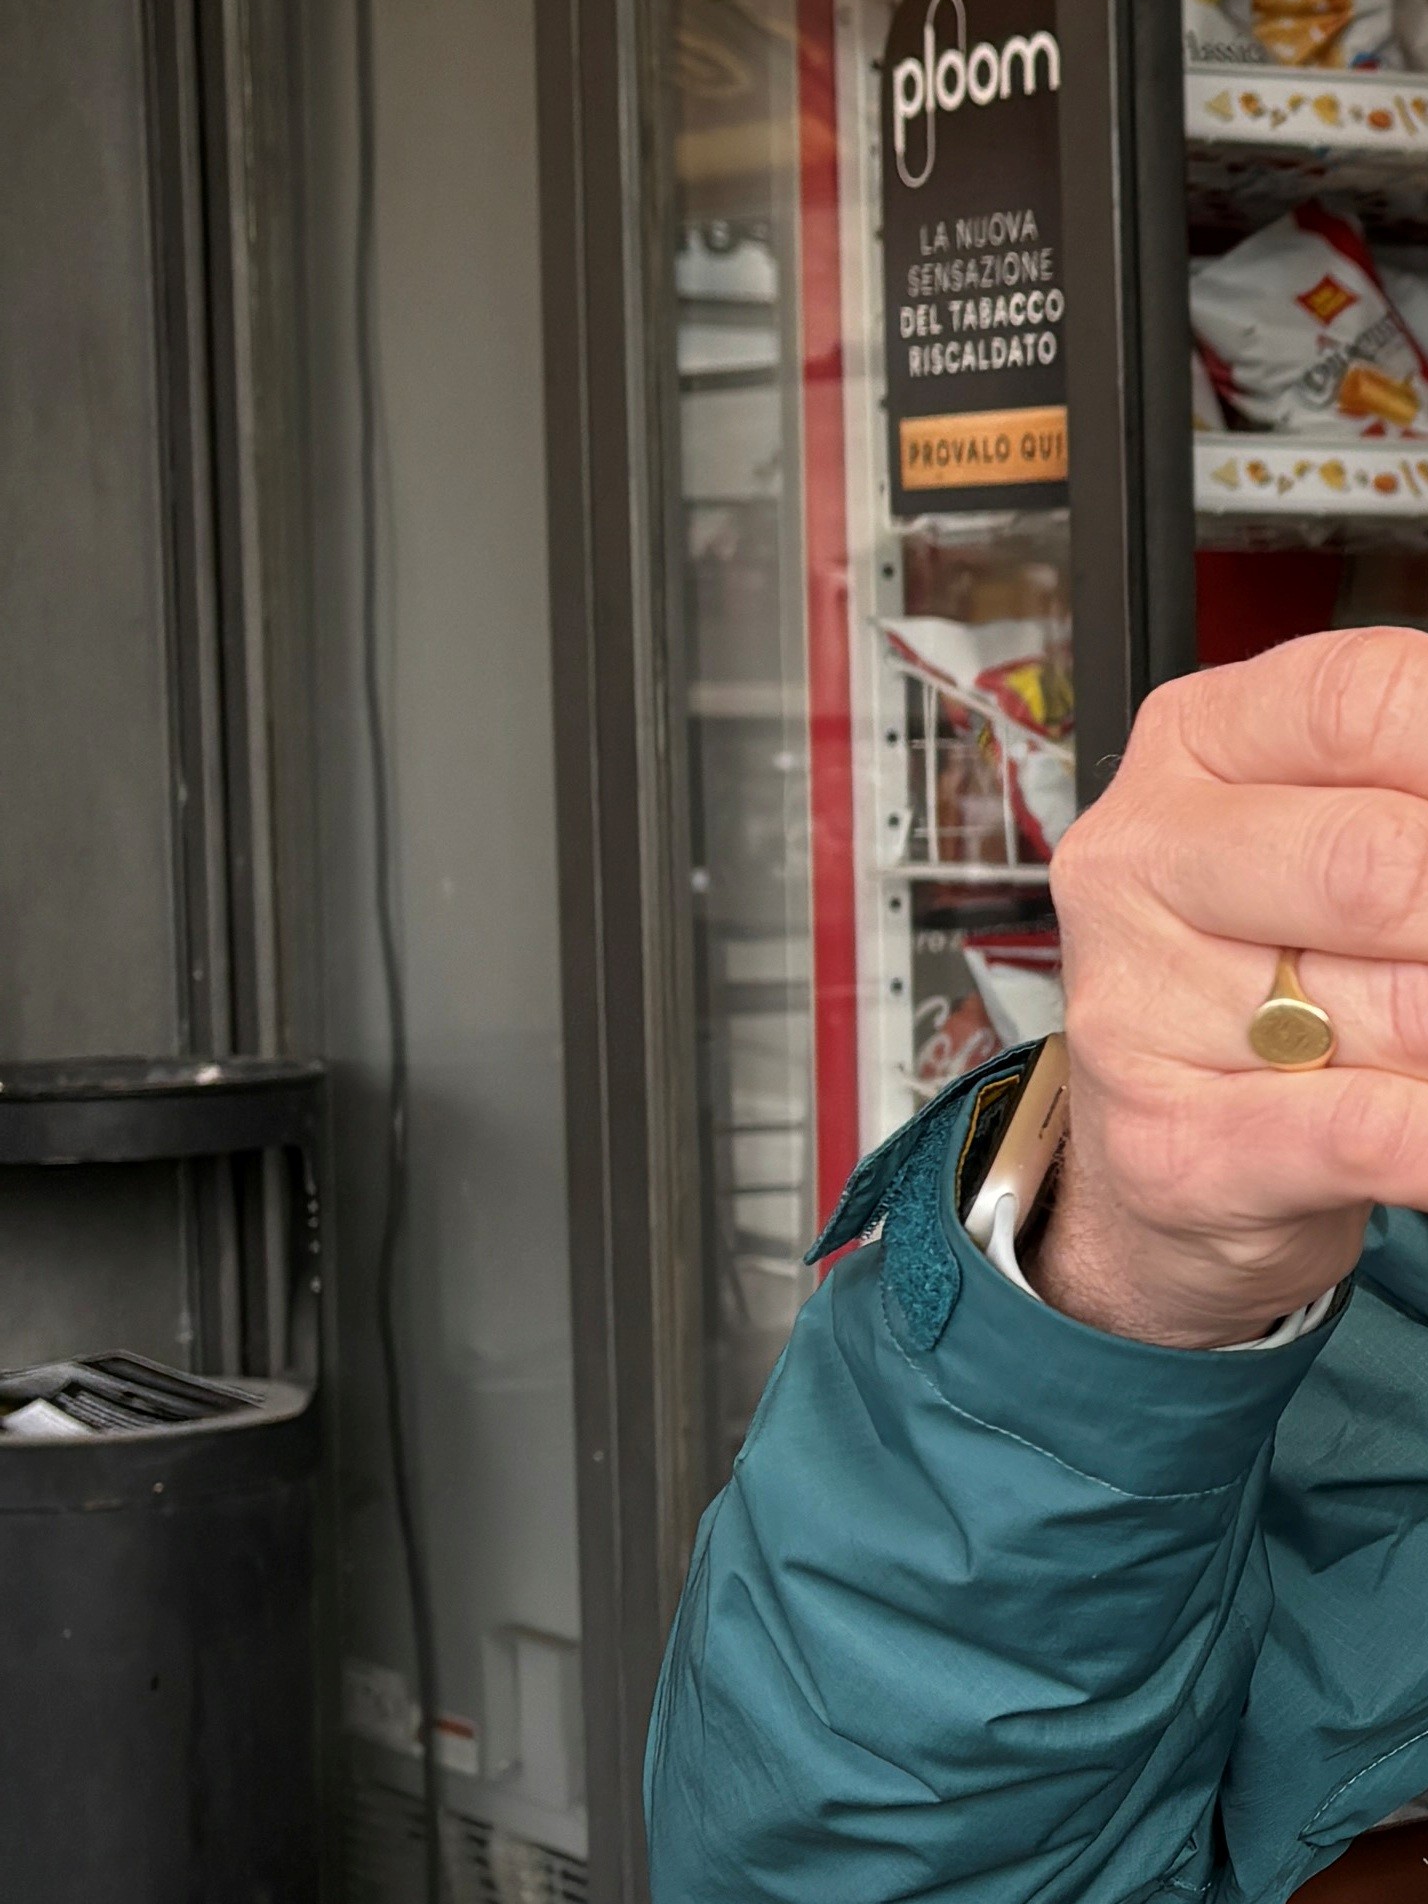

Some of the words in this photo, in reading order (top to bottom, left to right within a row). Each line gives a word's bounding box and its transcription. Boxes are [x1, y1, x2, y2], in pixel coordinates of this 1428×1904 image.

[918, 219, 949, 257] LA
[955, 209, 1040, 252] NUOVA
[906, 247, 1055, 298] SENSAZIONE
[900, 303, 943, 339] DEL
[949, 288, 1065, 331] TABACCO
[908, 332, 1058, 377] RISCALDATO
[908, 434, 1010, 469] PROVALO
[1020, 430, 1064, 462] QUI
